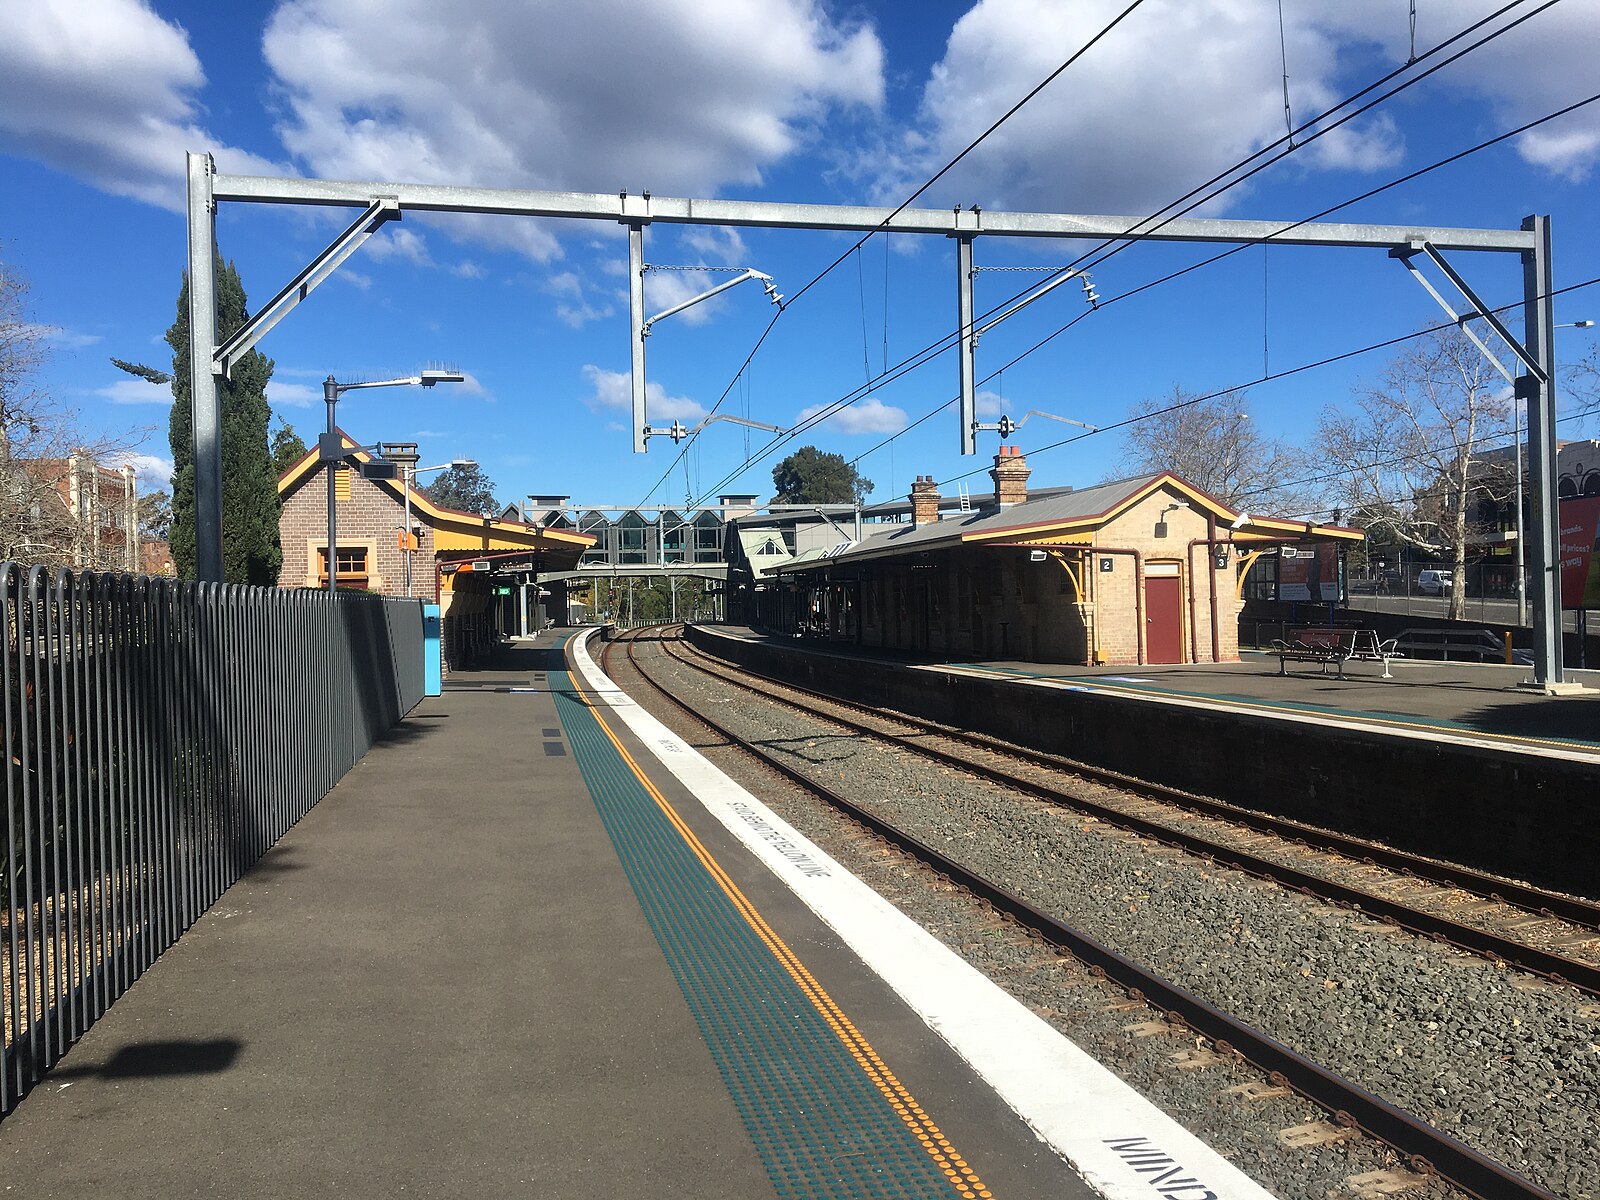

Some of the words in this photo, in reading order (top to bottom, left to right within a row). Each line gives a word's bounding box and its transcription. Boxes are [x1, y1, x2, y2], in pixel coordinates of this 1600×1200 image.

[1103, 560, 1110, 570] 2
[1218, 558, 1224, 567] 3
[1565, 556, 1582, 567] way
[795, 863, 833, 878] LINE
